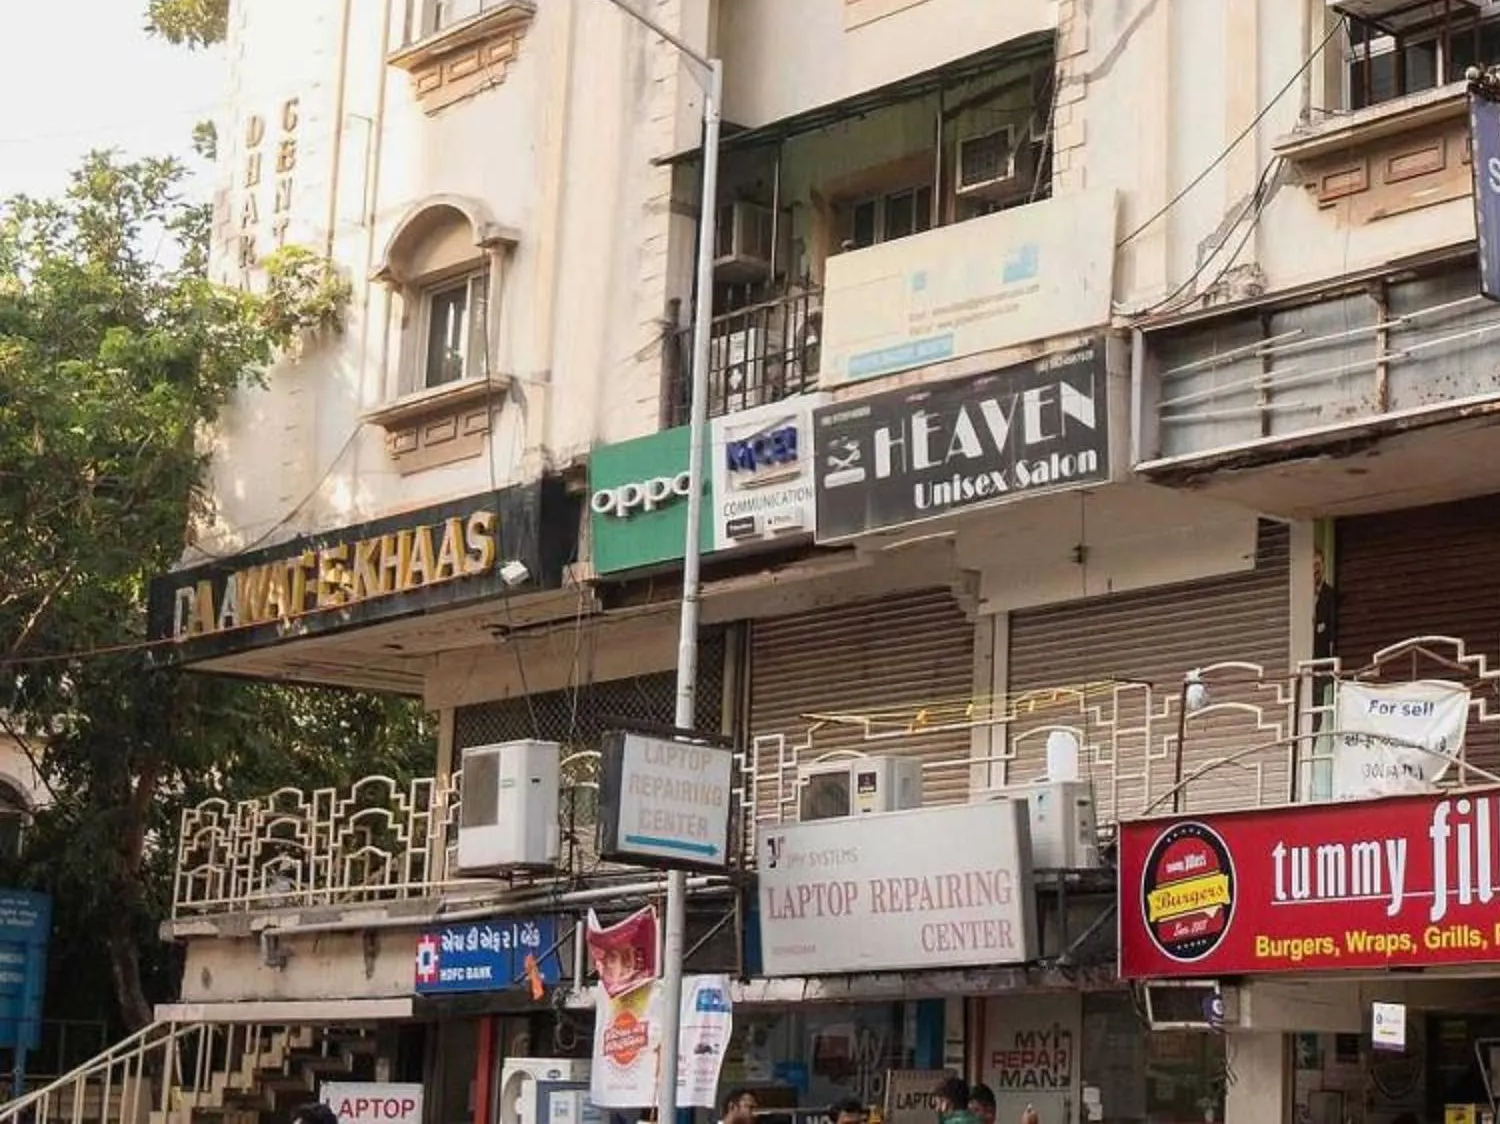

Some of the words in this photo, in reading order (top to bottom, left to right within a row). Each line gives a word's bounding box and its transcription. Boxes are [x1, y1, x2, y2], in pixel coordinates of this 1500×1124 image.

[875, 373, 1096, 479] HEAVEN
[591, 470, 691, 517] oppo
[914, 467, 1008, 509] Unisex
[1015, 448, 1098, 485] Salon
[1368, 699, 1396, 716] For
[1401, 701, 1435, 717] sell
[643, 741, 712, 773] LAPTOP
[628, 774, 722, 807] REPAIRING
[639, 809, 708, 838] CENTER
[1271, 837, 1407, 917] tummy
[766, 880, 859, 919] LAPTOP
[869, 869, 1012, 914] REPAIRING
[1156, 884, 1224, 910] Burgers
[921, 919, 1015, 953] CENTER
[1254, 933, 1341, 961] Burgers,
[1345, 928, 1417, 957] Wraps,
[1424, 925, 1488, 951] Grills,
[440, 967, 465, 981] HDFC
[466, 965, 493, 980] BANK
[1000, 1069, 1058, 1088] MAN
[896, 1091, 937, 1110] LAPTO
